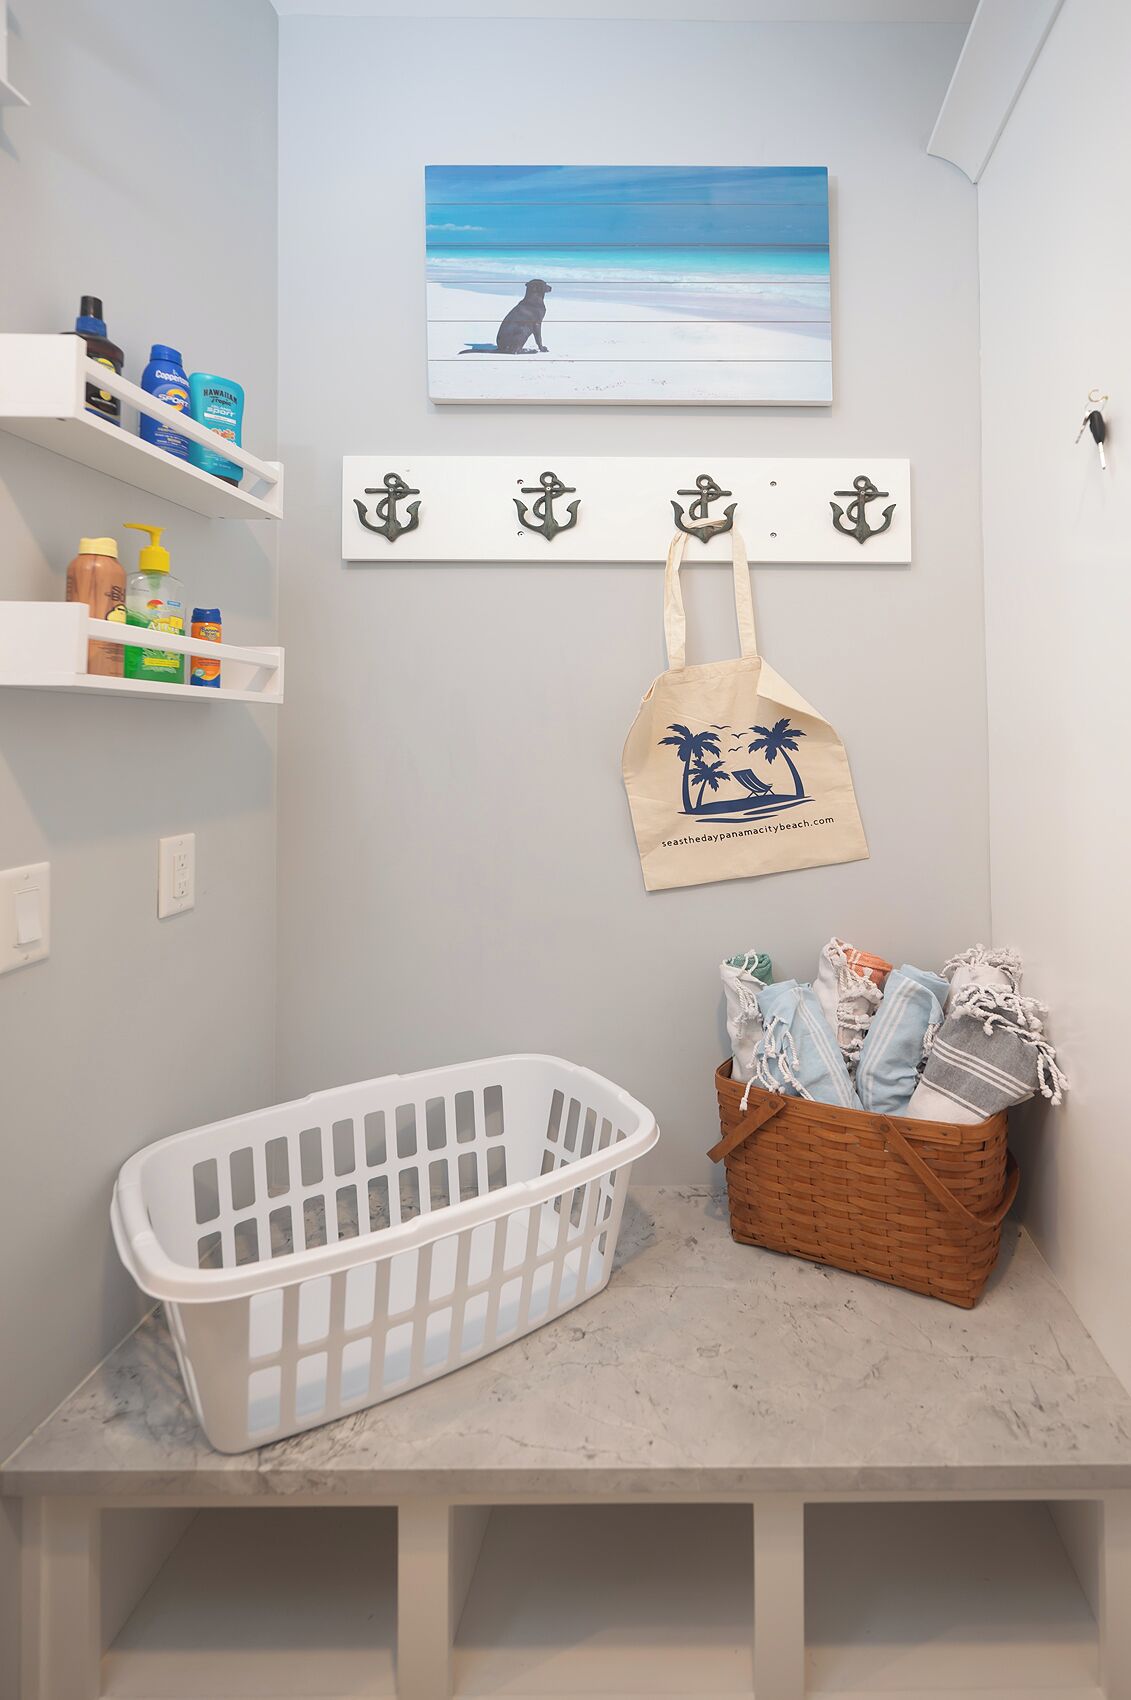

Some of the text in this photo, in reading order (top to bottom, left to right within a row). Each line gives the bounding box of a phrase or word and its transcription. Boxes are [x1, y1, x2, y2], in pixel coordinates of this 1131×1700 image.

[155, 370, 189, 387] Copper
[203, 388, 238, 405] HAWAIIAN
[662, 816, 835, 847] seasthedaypanamacitybeach.com
